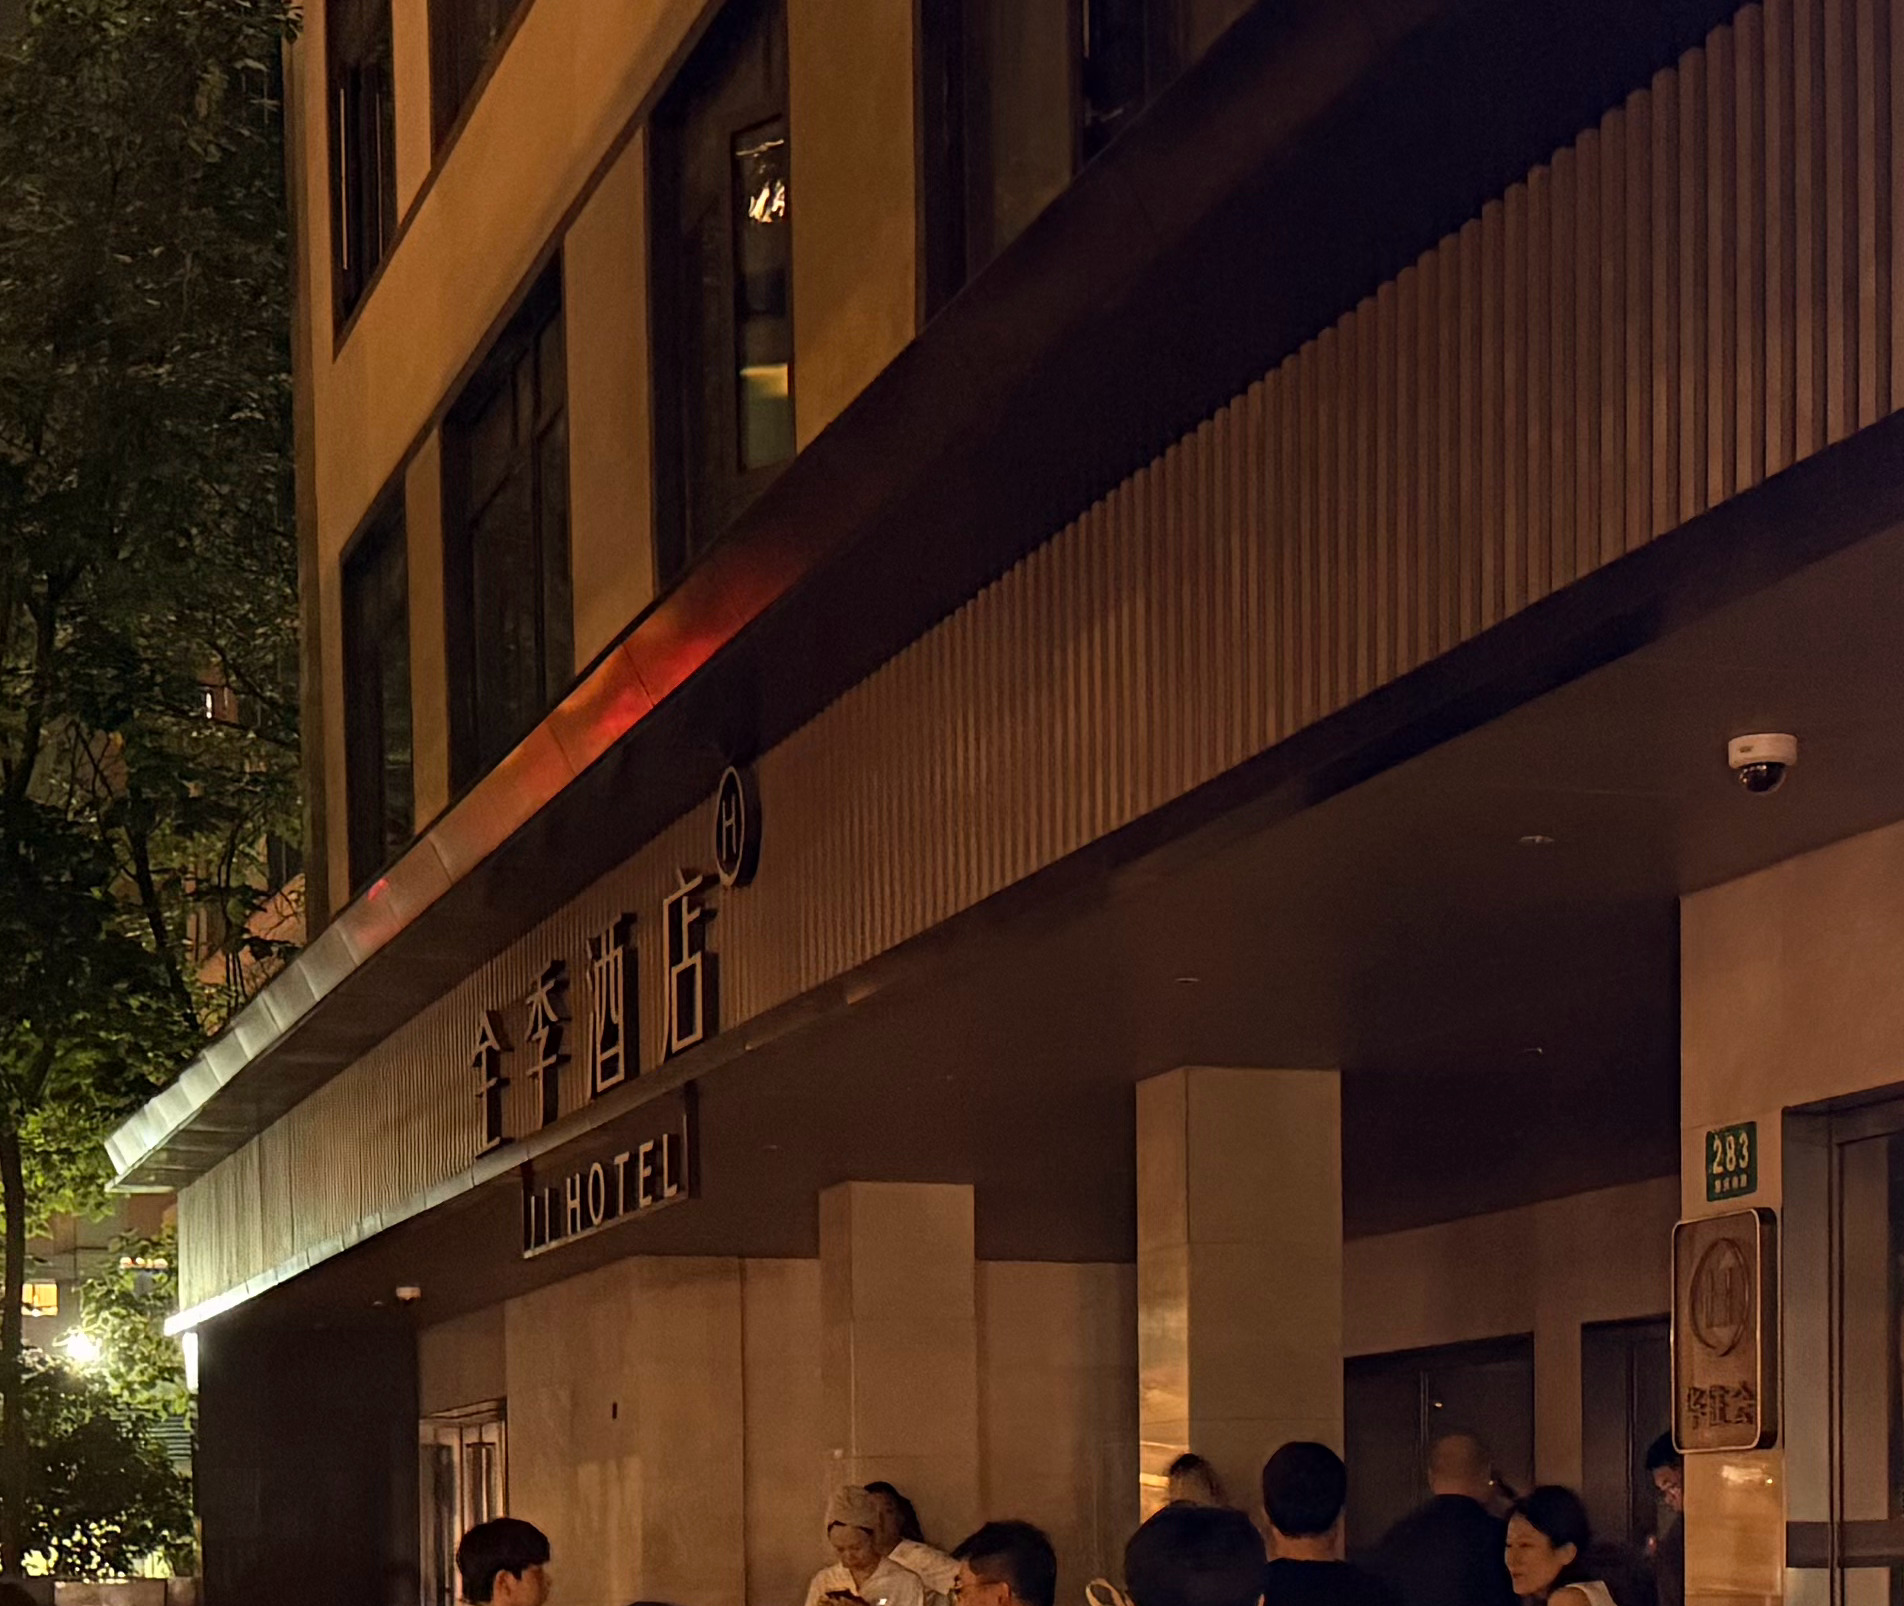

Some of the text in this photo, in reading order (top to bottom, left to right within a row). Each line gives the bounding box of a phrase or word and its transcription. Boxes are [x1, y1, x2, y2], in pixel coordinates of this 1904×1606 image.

[471, 867, 704, 1161] 全季酒店
[566, 1132, 679, 1237] HOTEL
[1712, 1130, 1749, 1175] 283
